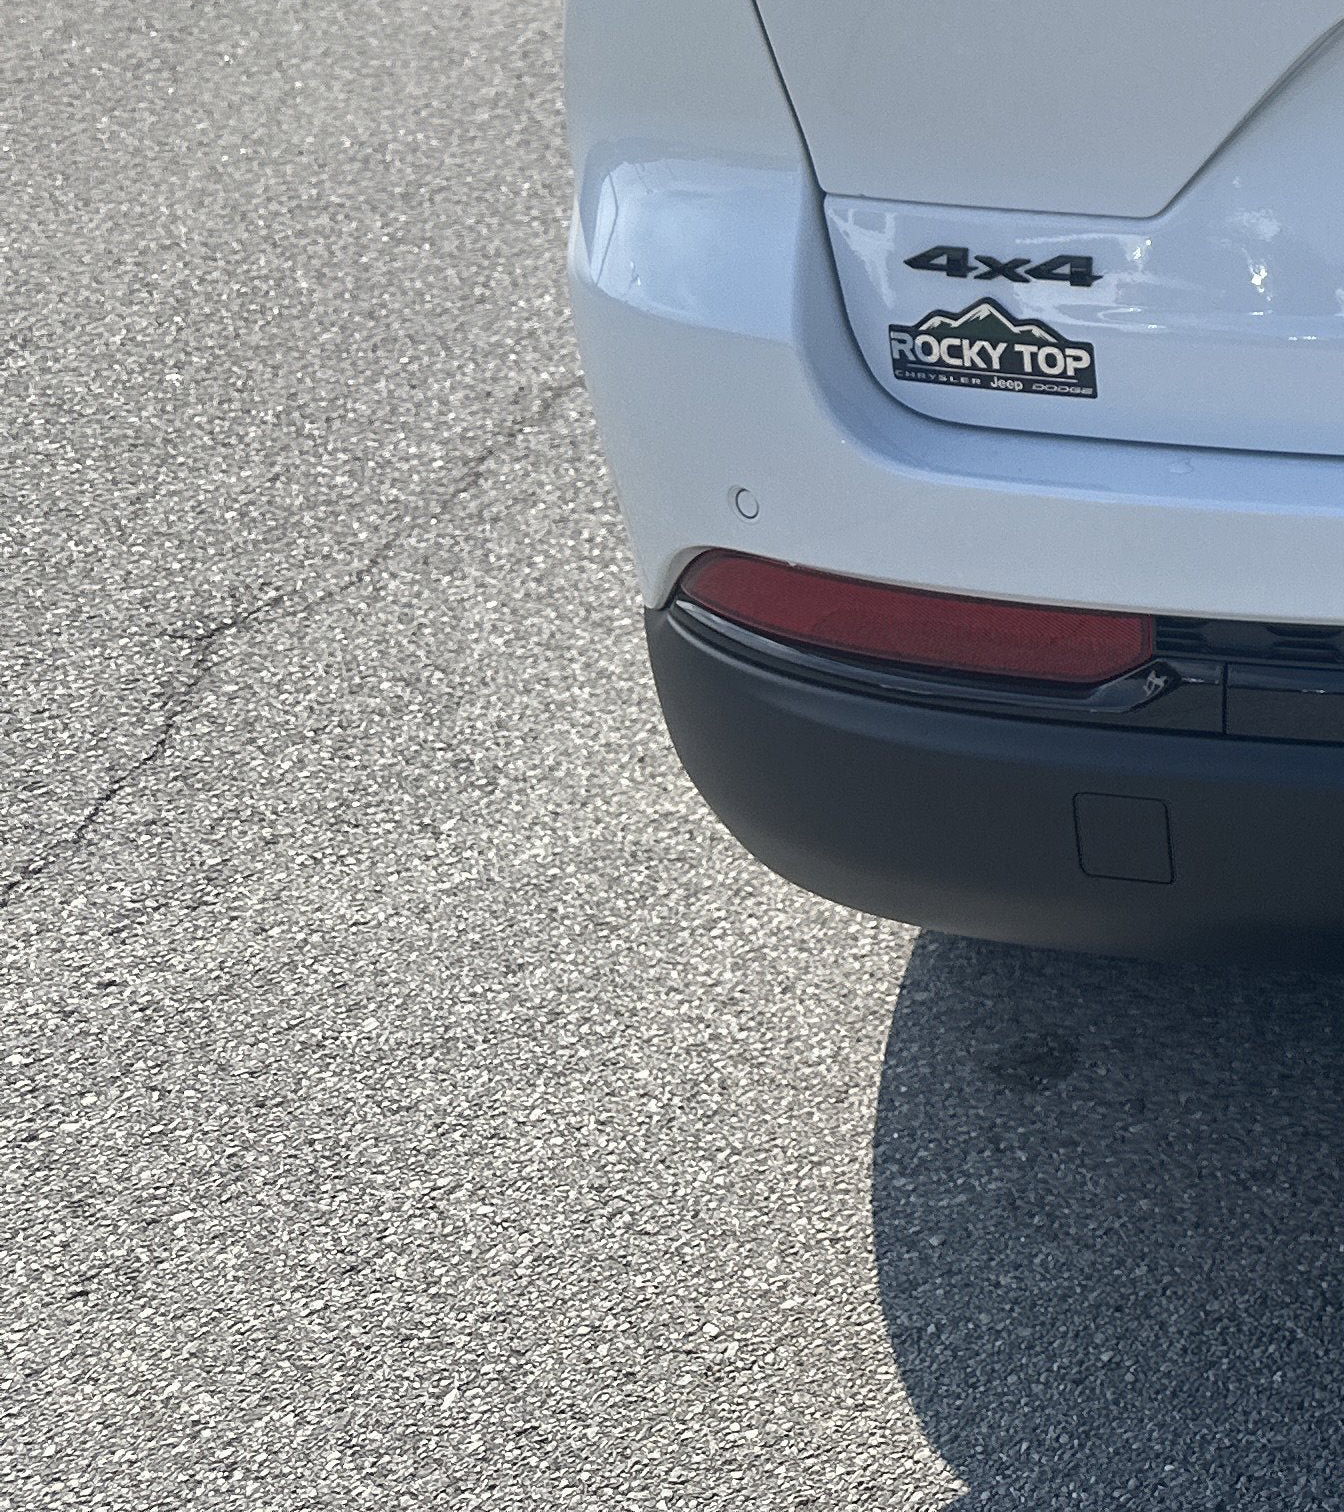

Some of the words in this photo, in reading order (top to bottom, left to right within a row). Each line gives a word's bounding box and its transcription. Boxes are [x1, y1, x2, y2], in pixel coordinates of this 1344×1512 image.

[903, 244, 1103, 287] 4x4
[890, 331, 1009, 370] ROCKY
[1014, 344, 1091, 376] TOP
[895, 369, 982, 385] CHRYSLER
[990, 375, 1025, 391] Jeep
[1032, 383, 1094, 395] DODGE
